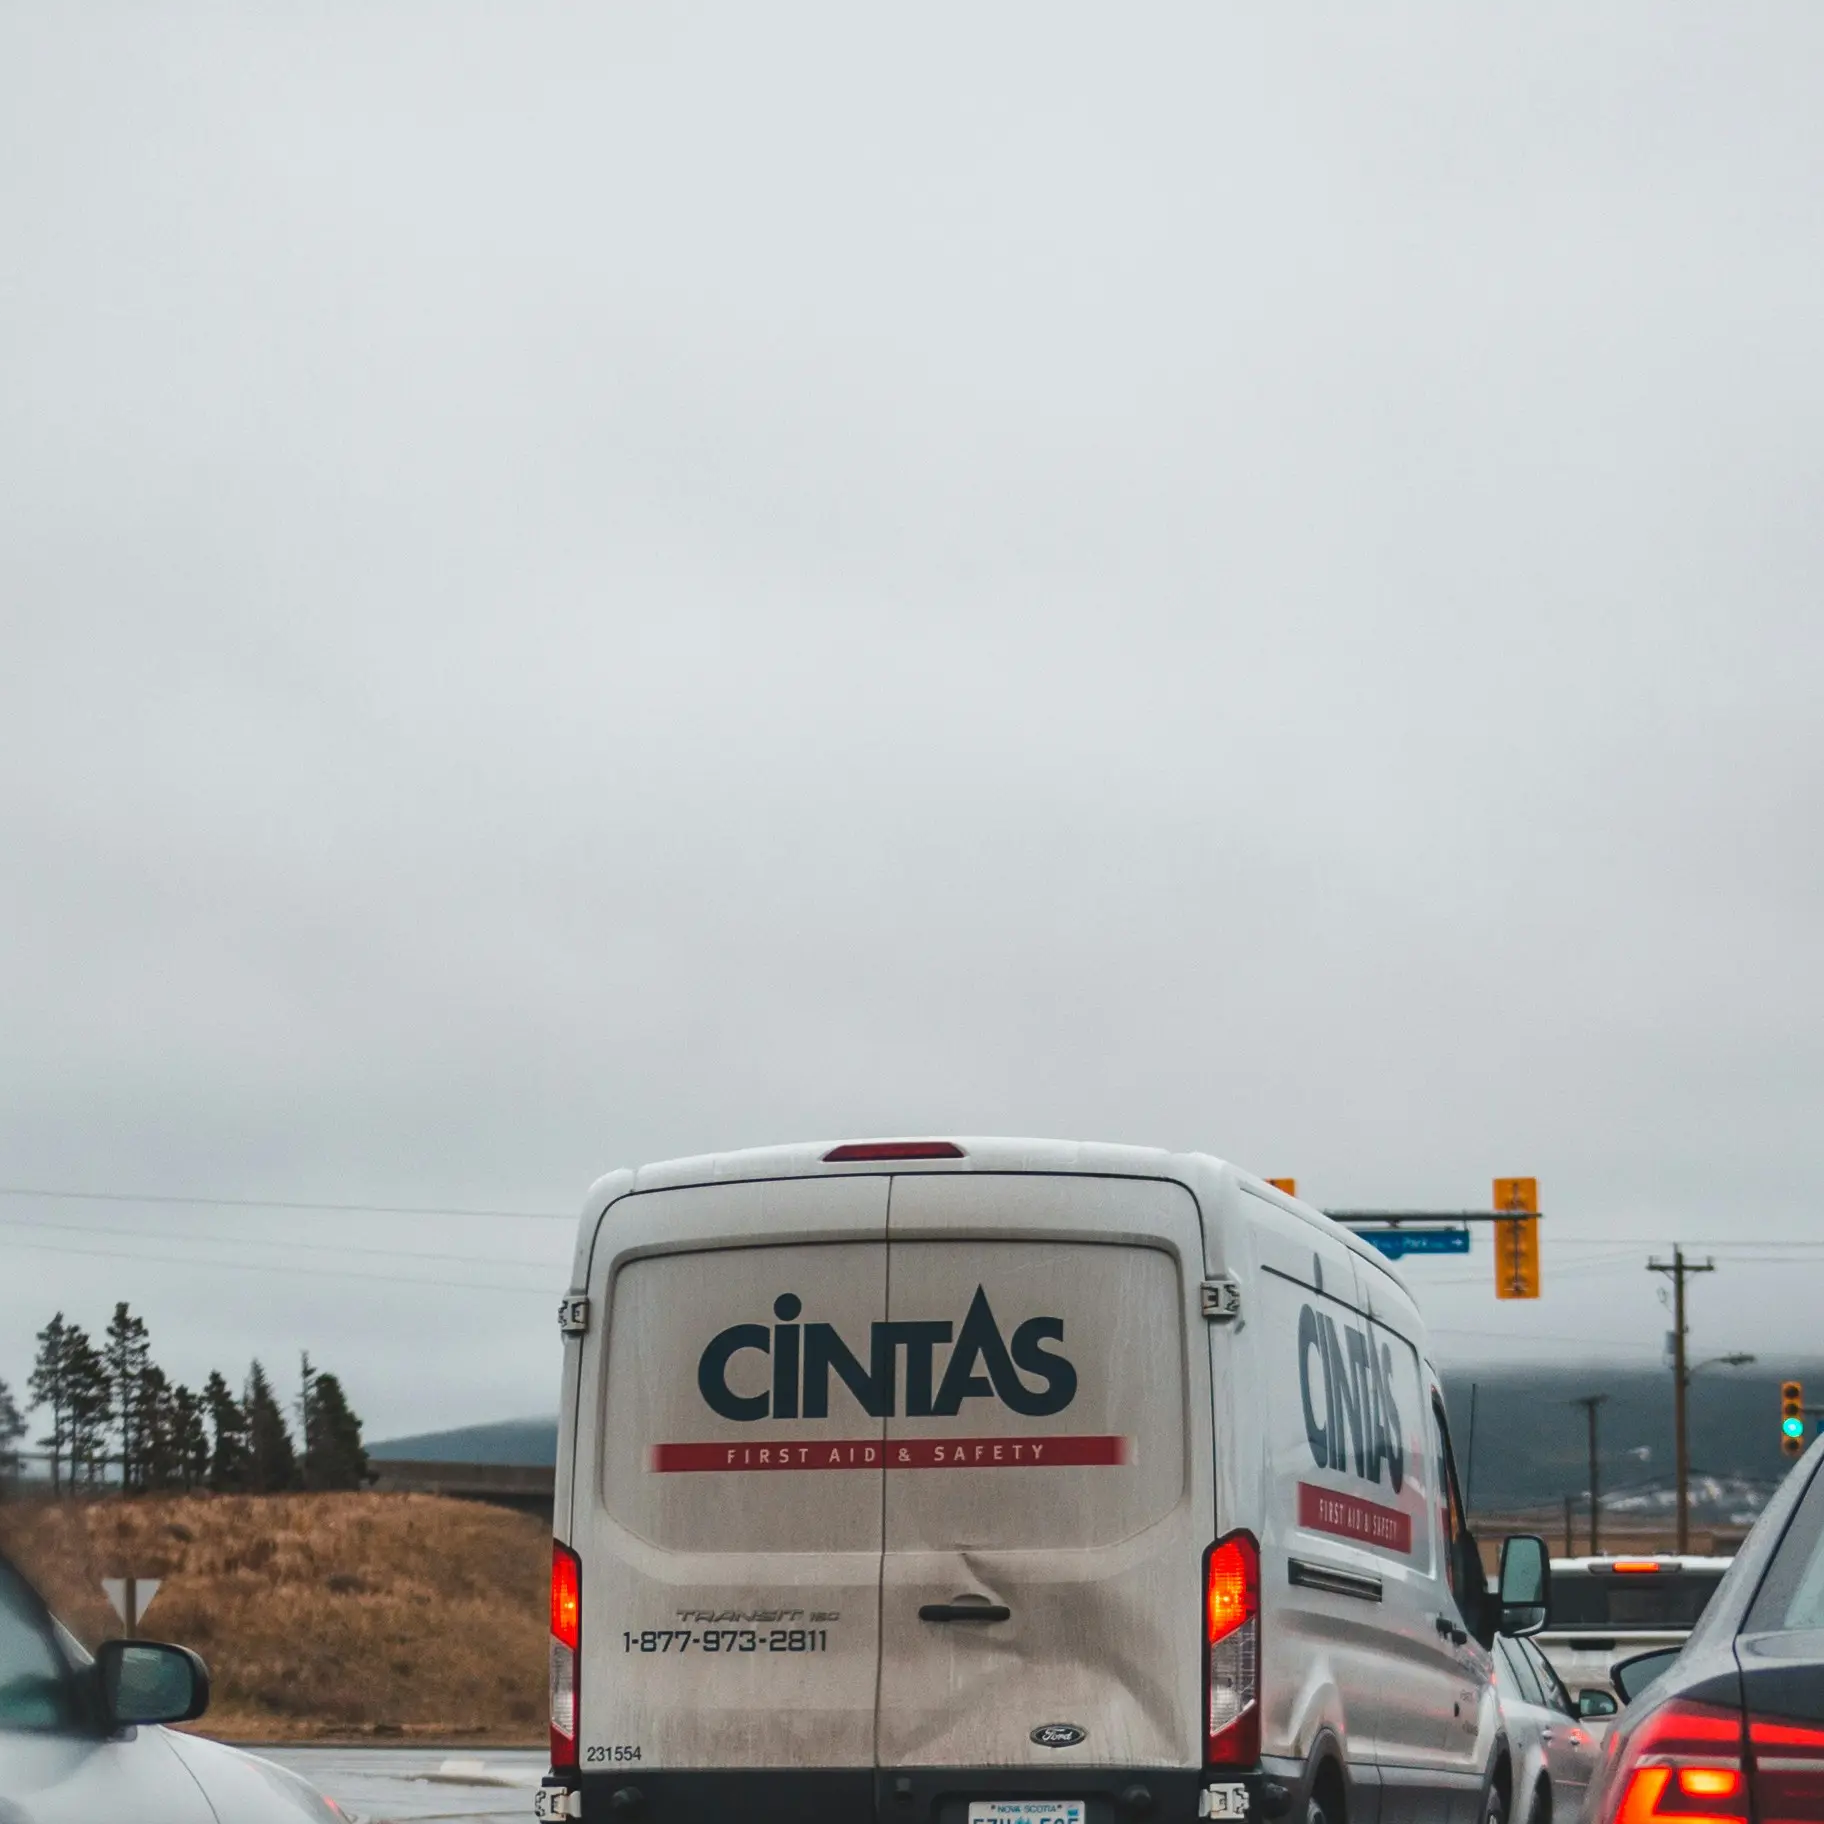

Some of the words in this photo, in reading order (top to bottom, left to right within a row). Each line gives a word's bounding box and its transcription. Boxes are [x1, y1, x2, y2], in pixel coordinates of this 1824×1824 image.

[727, 1447, 809, 1464] FIRST
[829, 1447, 876, 1462] AID
[897, 1447, 911, 1462] &
[933, 1444, 1044, 1461] SAFETY
[1319, 1498, 1344, 1525] FIRST
[1373, 1514, 1398, 1541] SAFETY
[676, 1609, 805, 1622] TRANSIT
[623, 1629, 829, 1652] 1-877-973-2811
[587, 1745, 642, 1761] 231554
[998, 1804, 1021, 1813] NOVA
[1024, 1803, 1057, 1813] SCOTIA
